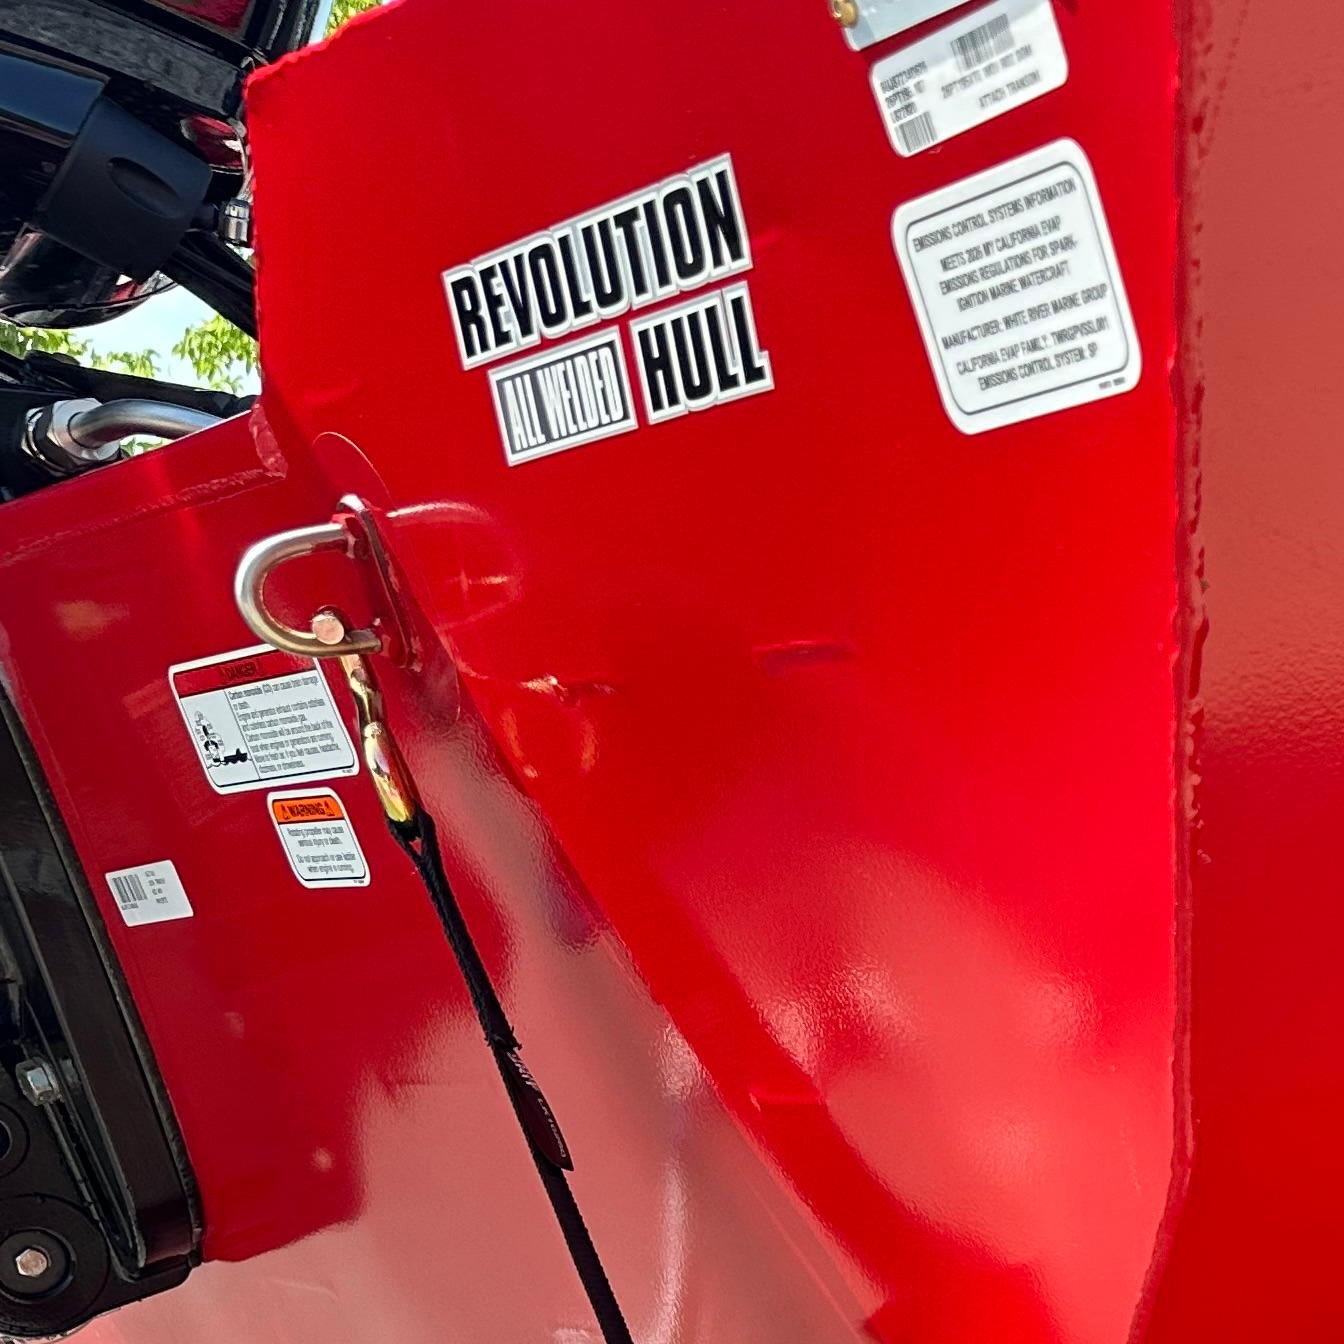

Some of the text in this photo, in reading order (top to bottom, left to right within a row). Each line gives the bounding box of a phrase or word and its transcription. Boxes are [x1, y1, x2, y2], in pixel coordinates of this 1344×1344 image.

[912, 178, 1077, 252] EMISSIONS CONTROL SYSTEMS INFORMATION
[450, 168, 747, 360] REVOLUTION
[940, 250, 967, 272] MEETS
[995, 225, 1042, 254] CALIFORNIA
[1041, 214, 1062, 236] EVAP
[939, 269, 979, 296] EMISSIONS
[979, 250, 1033, 279] REGULATIONS
[1032, 244, 1049, 264] FOR
[956, 260, 1070, 312] IGNITION MARINE WATERCRAFT
[1002, 309, 1028, 332] WHITE
[1028, 302, 1051, 324] RIVER
[1050, 293, 1082, 315] MARINE
[1081, 282, 1108, 305] GROUP
[502, 295, 767, 451] ALL WELDED HULL
[956, 353, 1001, 375] CALIFORNIA
[1001, 344, 1022, 364] EVAP
[978, 367, 1018, 391] EMISSIONS
[1018, 358, 1056, 380] CONTROL
